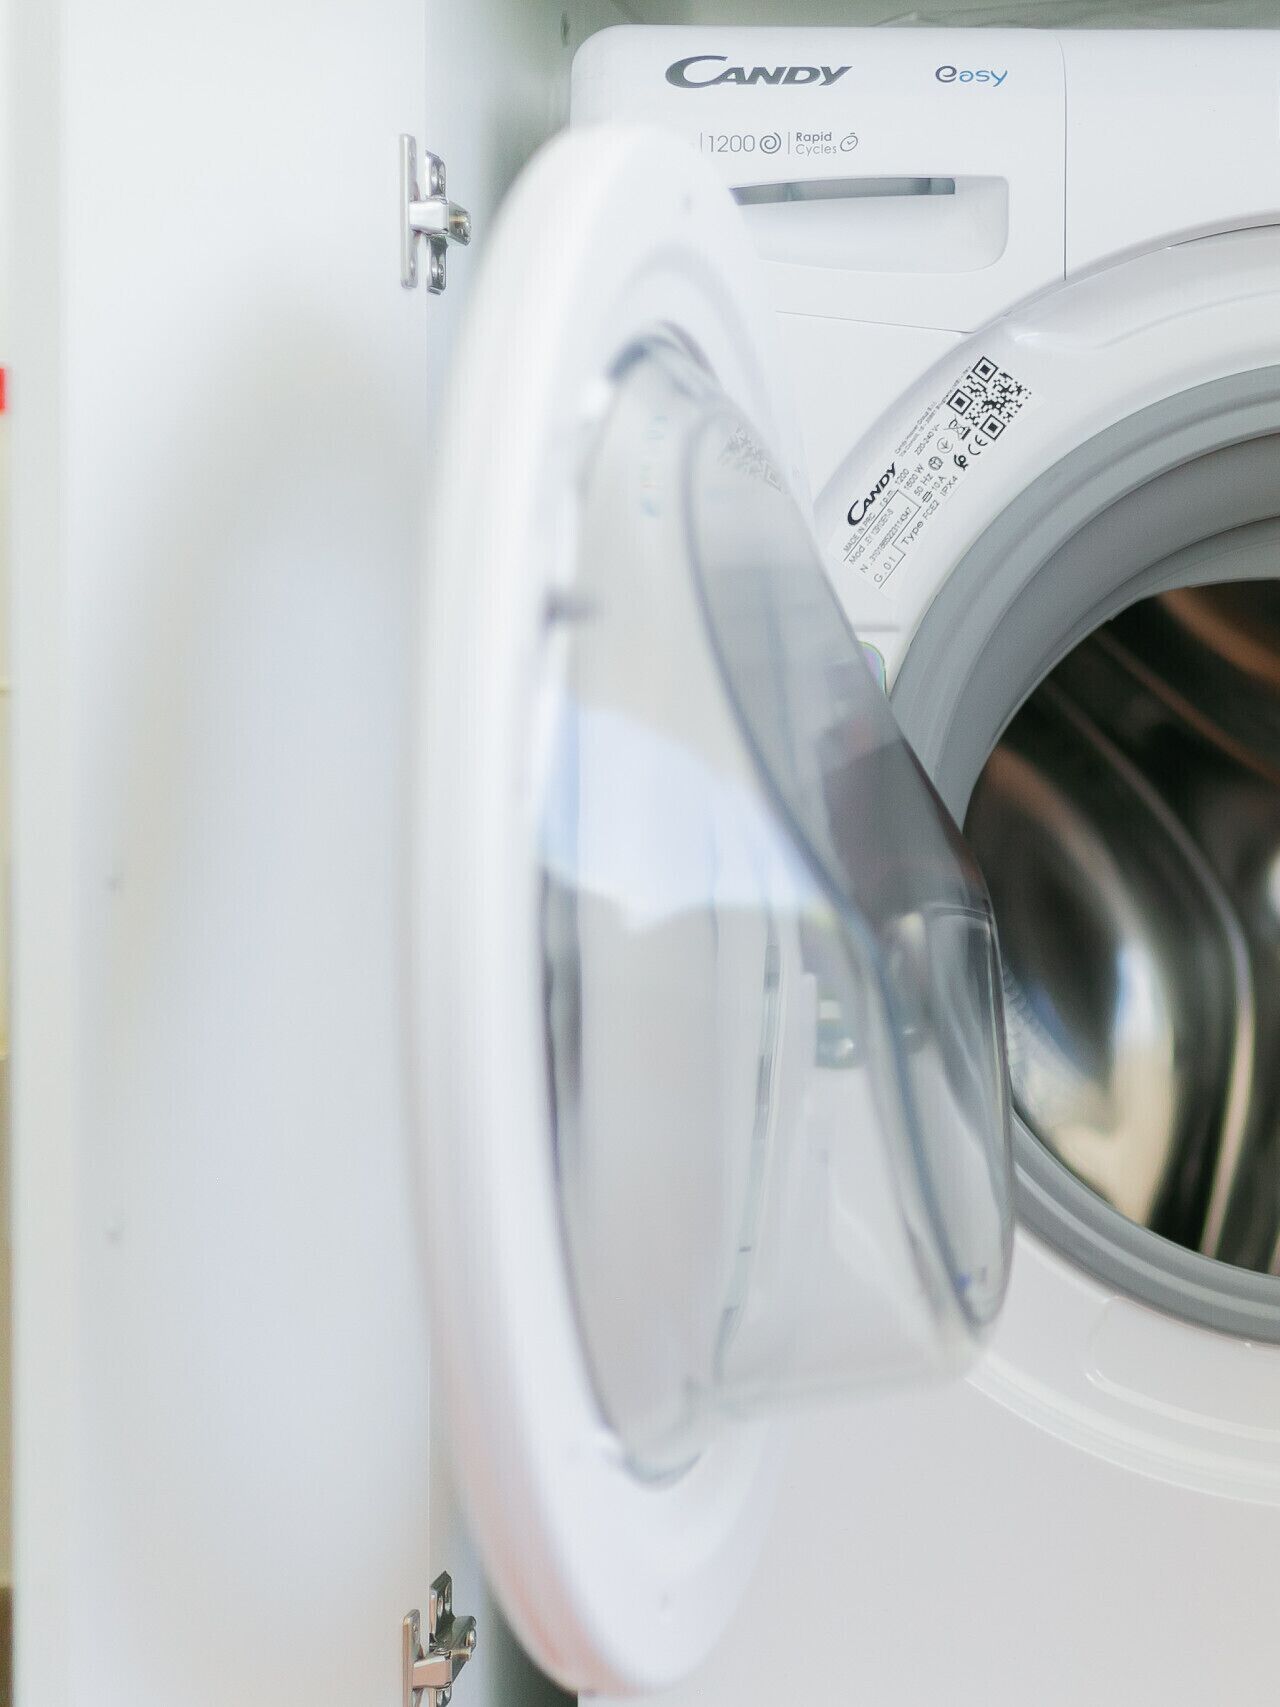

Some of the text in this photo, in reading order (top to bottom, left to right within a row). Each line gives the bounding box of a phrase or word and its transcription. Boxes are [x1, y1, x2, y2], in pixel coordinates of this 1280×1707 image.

[665, 54, 853, 88] CANDY
[935, 64, 1009, 87] easy
[708, 134, 755, 153] 1200
[796, 131, 832, 144] Rapid
[796, 143, 838, 156] Cycles
[893, 467, 910, 486] 1200
[914, 464, 924, 474] W
[847, 461, 896, 526] CANDY
[913, 471, 933, 496] 50 Hz
[842, 534, 859, 552] MADE
[857, 526, 865, 534] IN
[900, 519, 925, 546] Type
